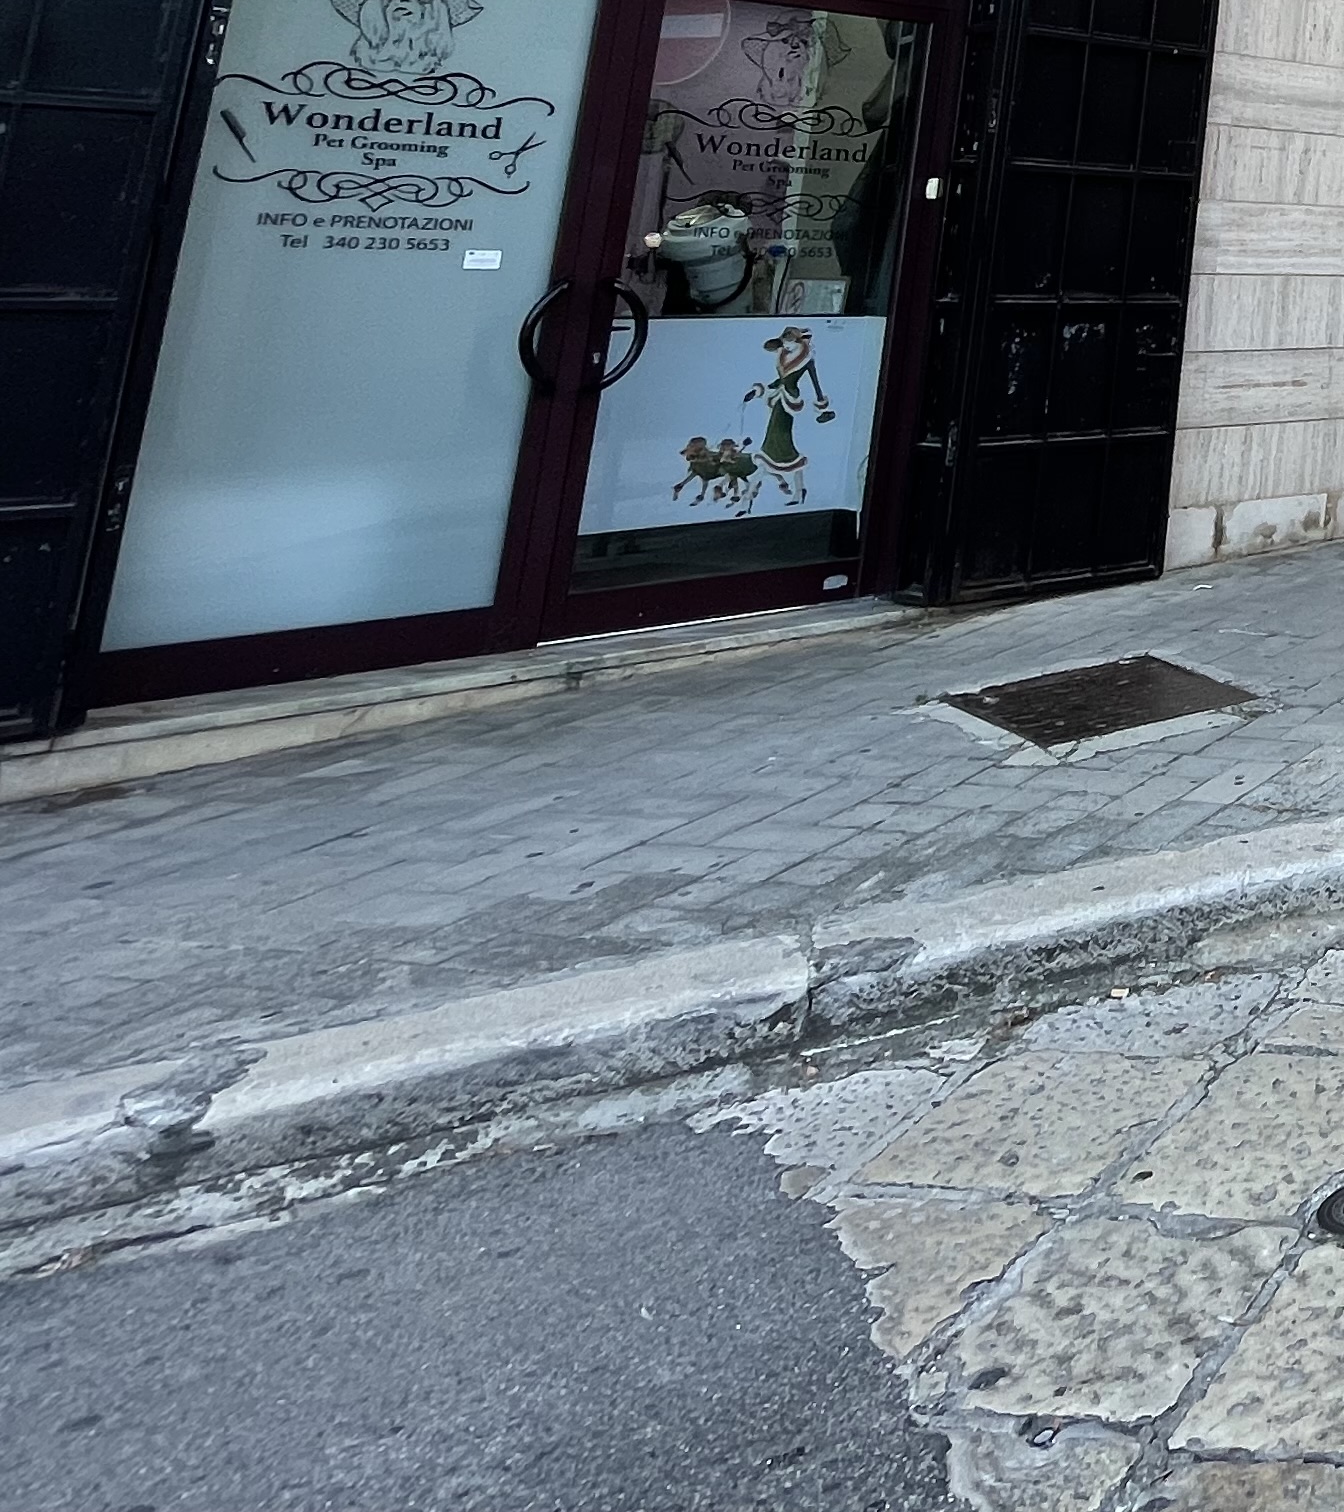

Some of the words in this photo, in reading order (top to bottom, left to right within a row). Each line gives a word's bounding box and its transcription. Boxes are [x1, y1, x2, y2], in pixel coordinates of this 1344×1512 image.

[263, 101, 503, 140] Wonderland
[313, 133, 345, 149] Pet
[351, 135, 450, 159] Grooming
[695, 133, 869, 163] Wonderland
[361, 152, 397, 170] Spa
[731, 159, 755, 172] Pet
[758, 160, 831, 180] Grooming
[767, 175, 792, 189] Spa
[257, 212, 308, 228] INFO
[312, 217, 326, 228] e
[330, 214, 474, 232] PRENOTAZIONI
[693, 226, 730, 239] INFO
[280, 234, 308, 249] Tel
[323, 235, 360, 249] 340
[364, 236, 400, 250] 230
[406, 237, 451, 252] 5653
[800, 246, 833, 258] 5653
